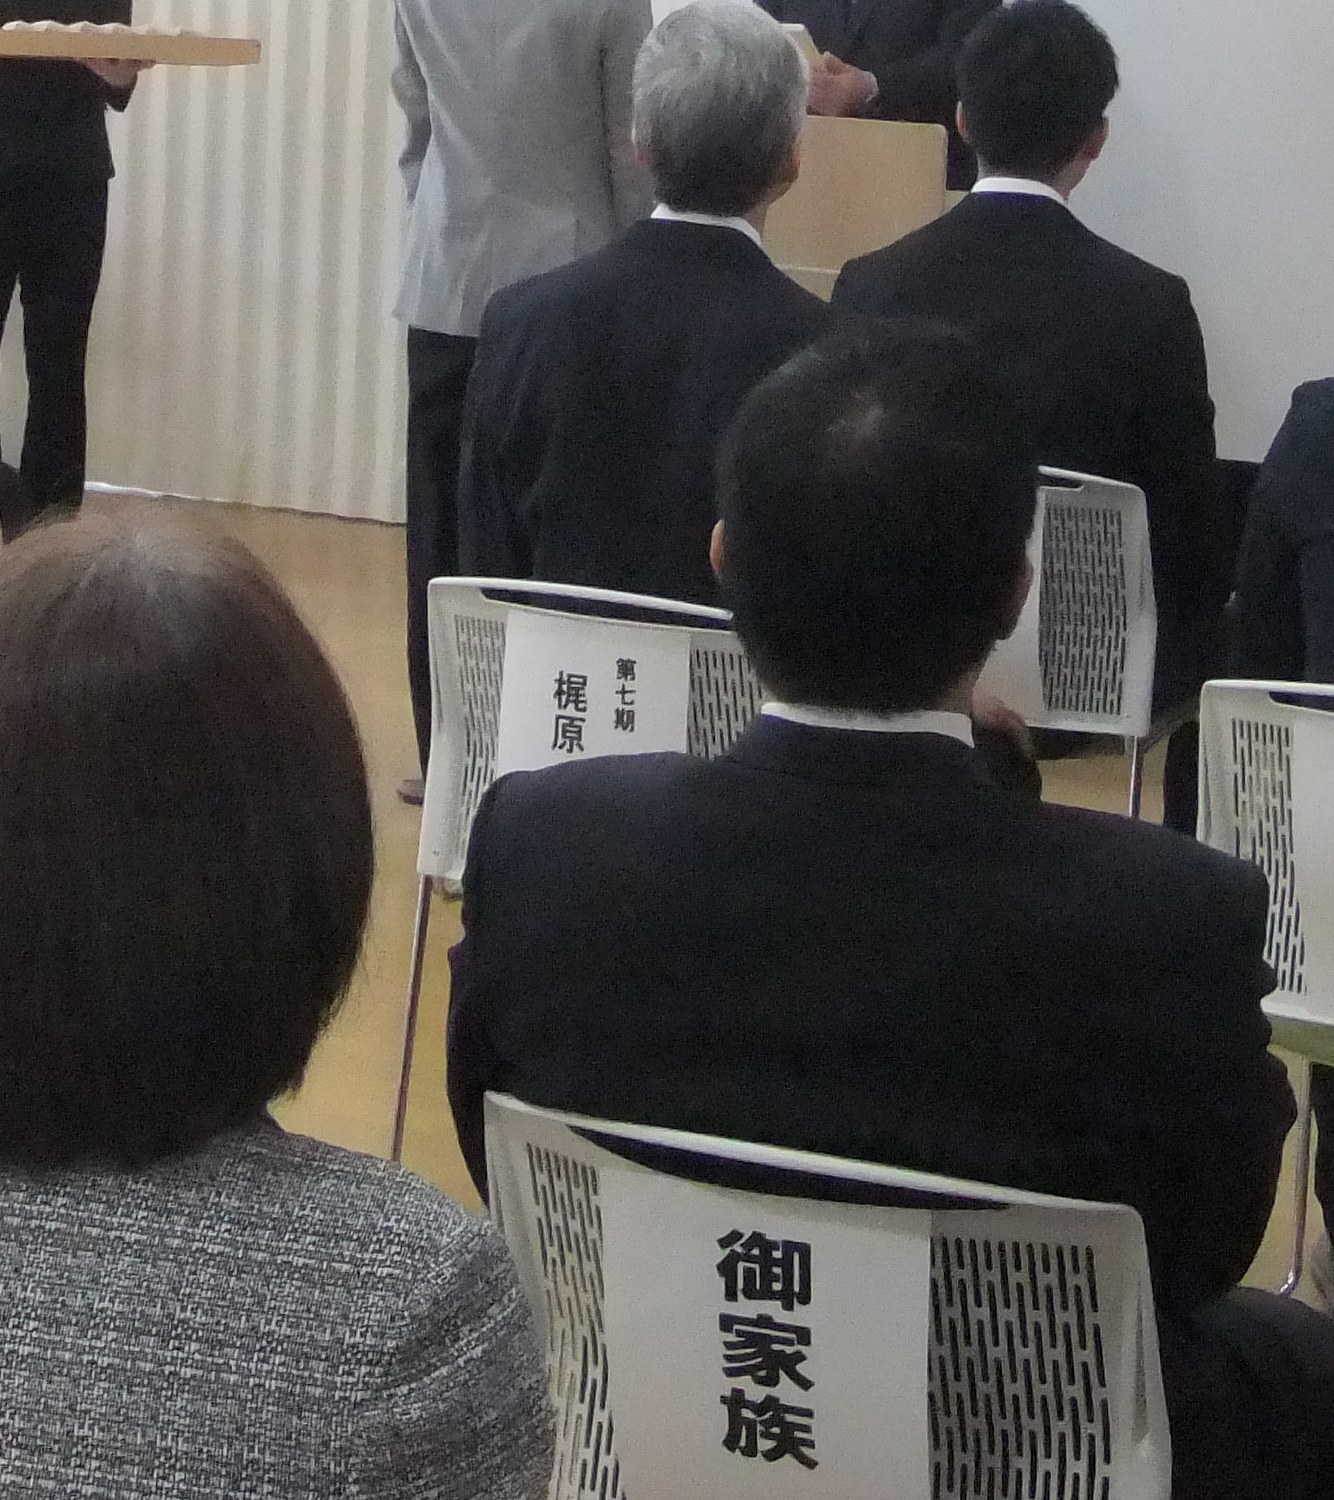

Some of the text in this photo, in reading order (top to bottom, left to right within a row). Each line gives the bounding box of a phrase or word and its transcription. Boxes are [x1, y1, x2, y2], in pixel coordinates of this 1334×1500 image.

[552, 669, 588, 753] 梶原
[615, 657, 637, 733] 第七期
[715, 1228, 820, 1472] 御家族
